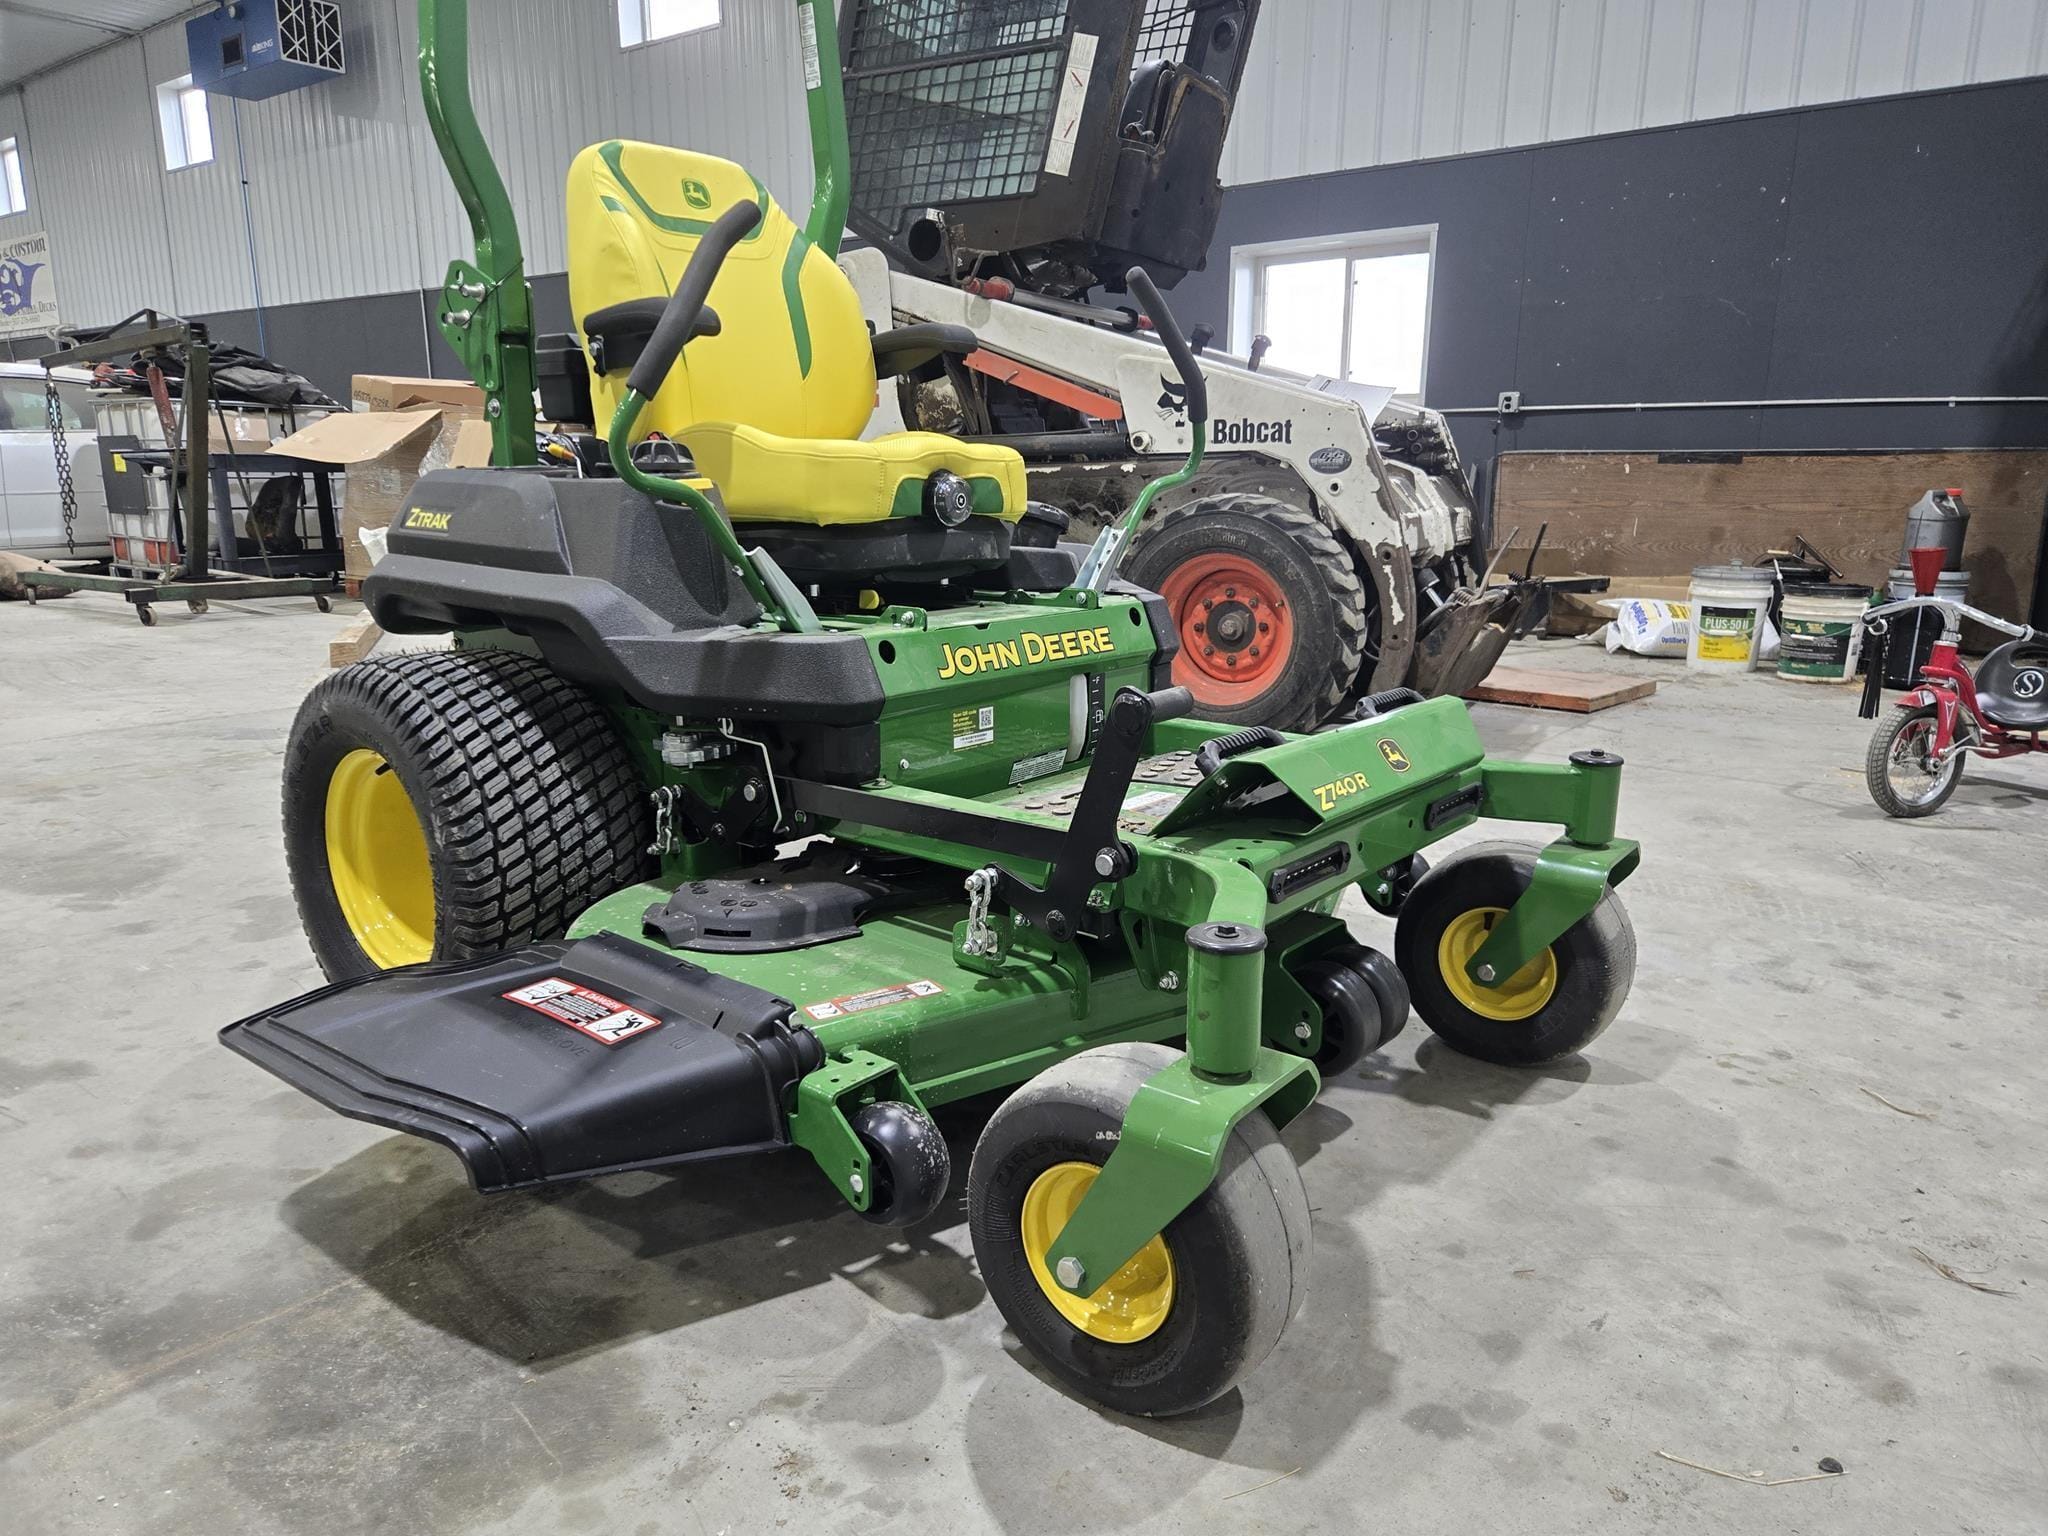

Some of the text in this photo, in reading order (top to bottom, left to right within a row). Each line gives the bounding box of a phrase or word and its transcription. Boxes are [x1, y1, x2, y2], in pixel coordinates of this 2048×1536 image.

[9, 237, 46, 258] CUSTOM
[1213, 418, 1292, 444] Bobcat
[405, 507, 452, 530] ZTRAK
[1705, 618, 1749, 630] PLUS-50 II
[938, 626, 1115, 679] JOHN DEERE
[2020, 673, 2036, 694] S
[1312, 771, 1371, 811] Z740R
[586, 992, 622, 1010] DANGER
